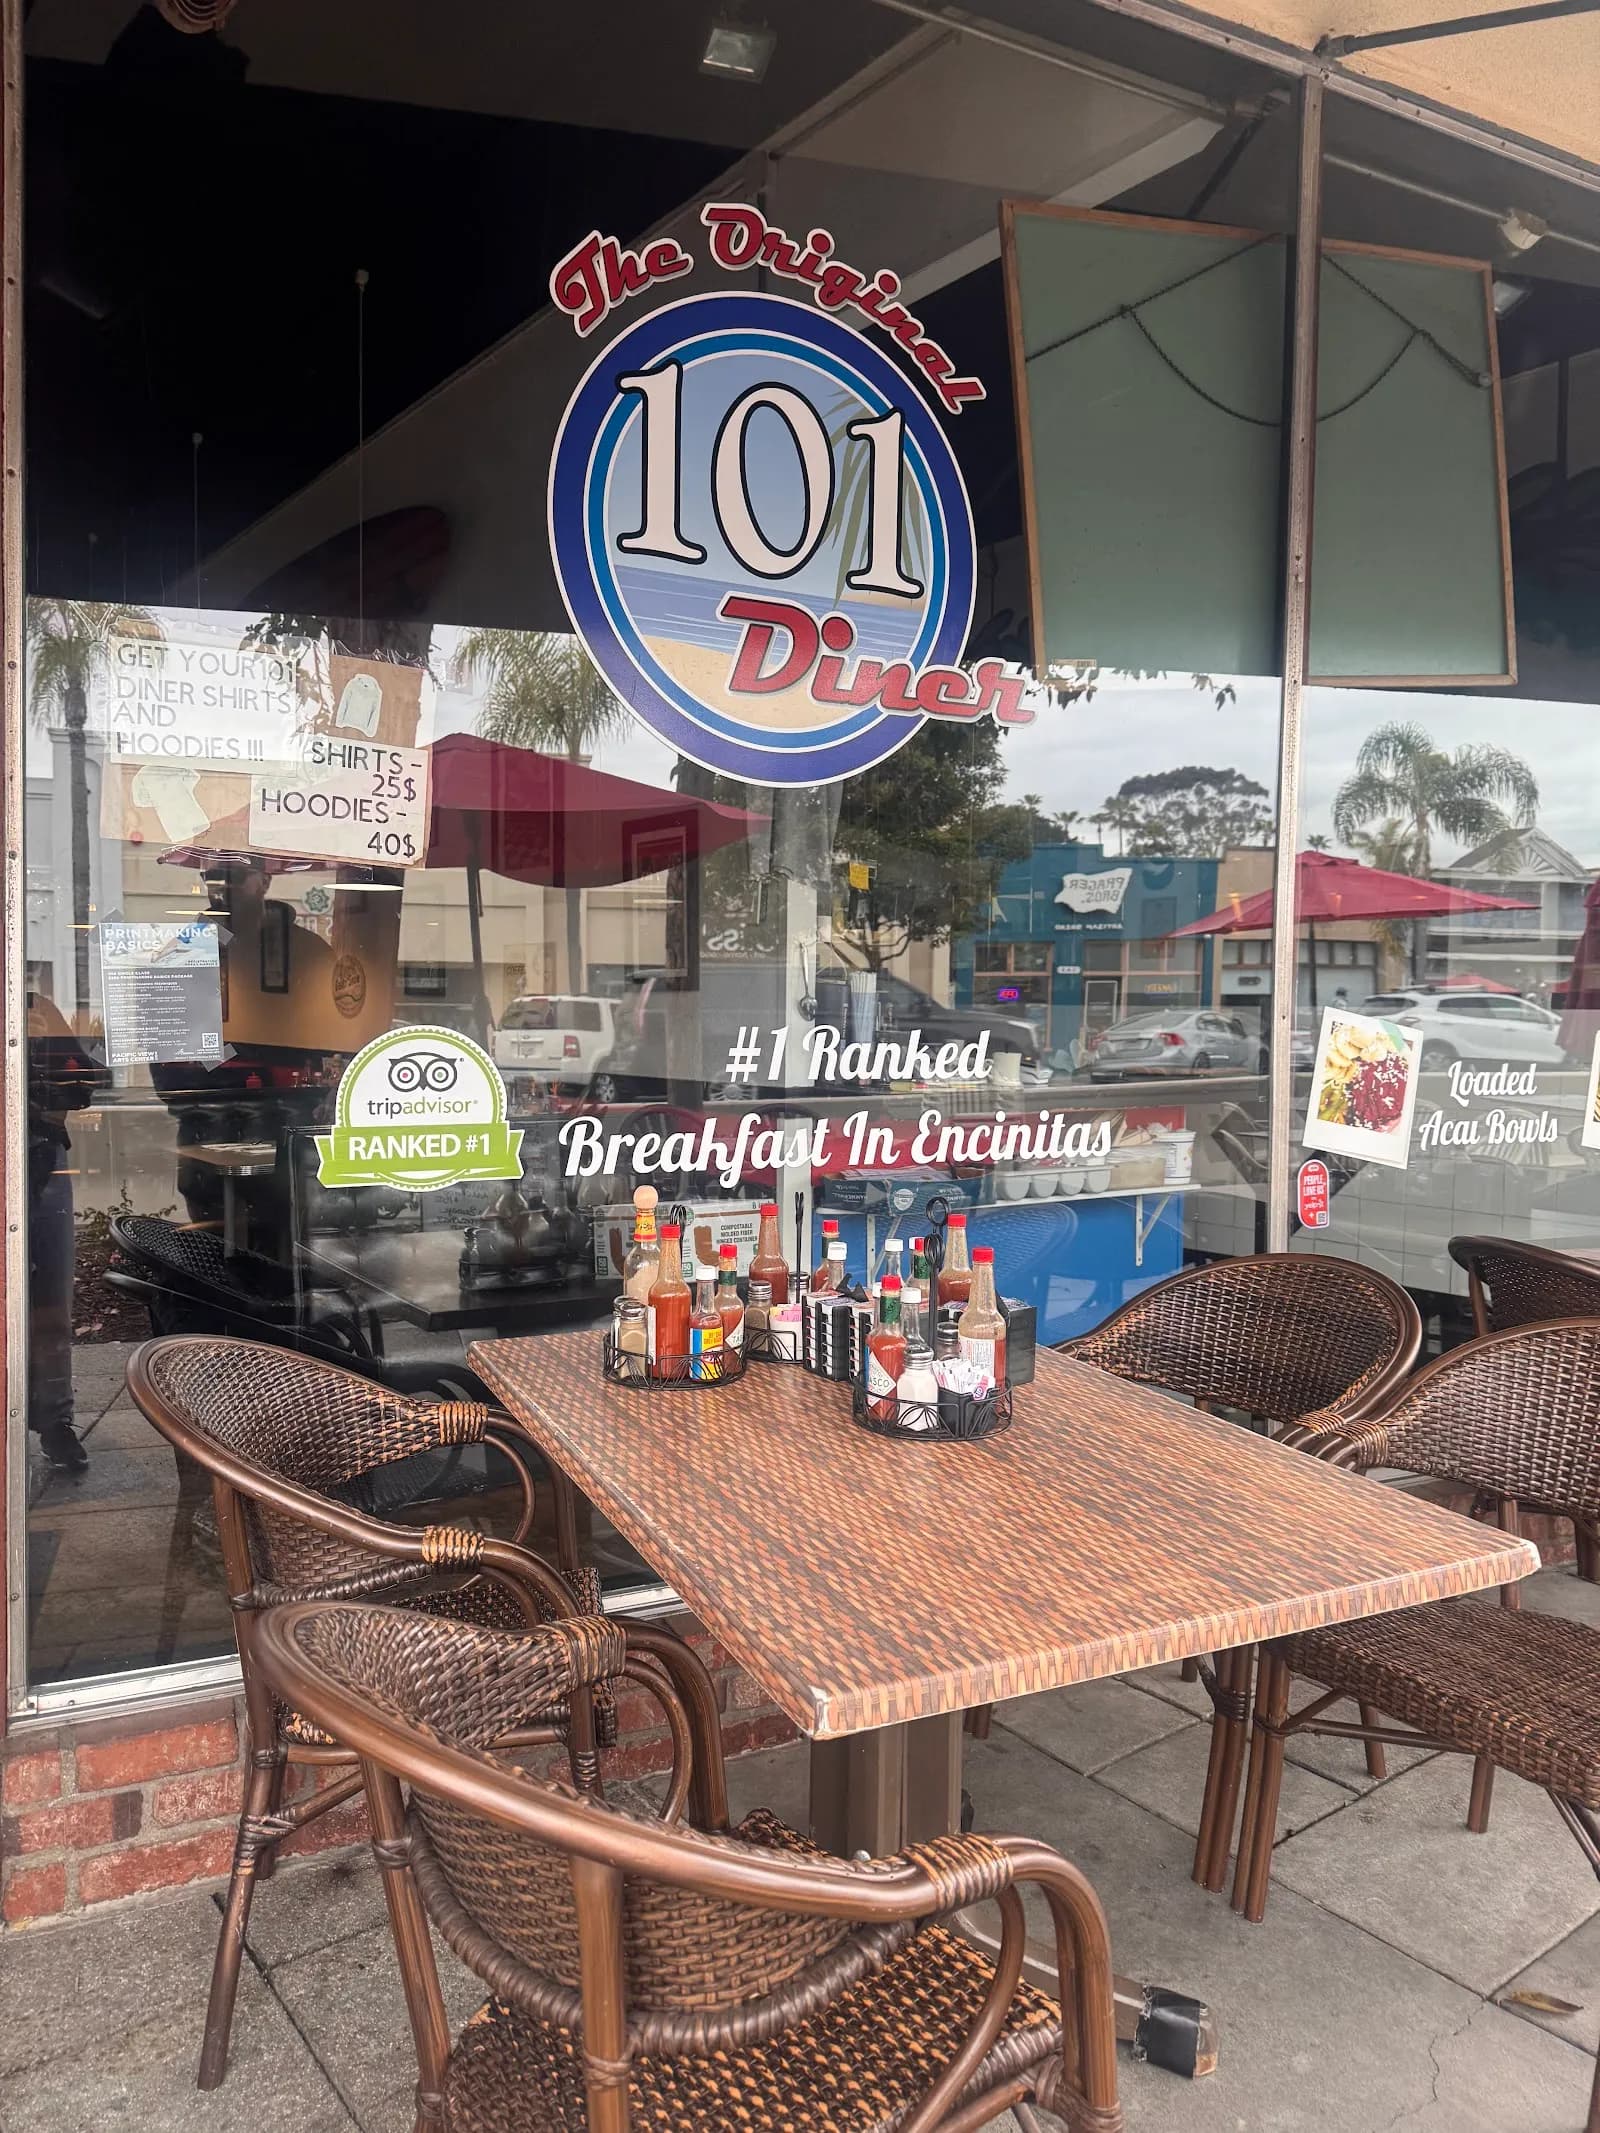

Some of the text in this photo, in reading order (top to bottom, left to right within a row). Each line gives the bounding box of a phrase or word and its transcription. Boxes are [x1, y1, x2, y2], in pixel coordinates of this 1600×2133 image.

[550, 202, 987, 415] The Original
[615, 358, 925, 599] 101
[117, 643, 168, 669] GET
[178, 650, 262, 678] YOUR
[715, 592, 1036, 726] Diner
[115, 675, 291, 715] DINER SHIRTS
[113, 703, 177, 727] AND
[371, 774, 417, 801] 25$
[367, 831, 416, 858] 40$
[105, 928, 212, 938] PRINTMAKING
[105, 940, 161, 951] BASICS
[725, 1024, 993, 1083] #1 Ranked
[1448, 1060, 1538, 1107] Loaded
[367, 1097, 471, 1119] tripadvisor
[1485, 1109, 1558, 1144] Bowls
[349, 1133, 490, 1161] RANKED #1
[558, 1109, 1113, 1189] Breakfast In Encinitas
